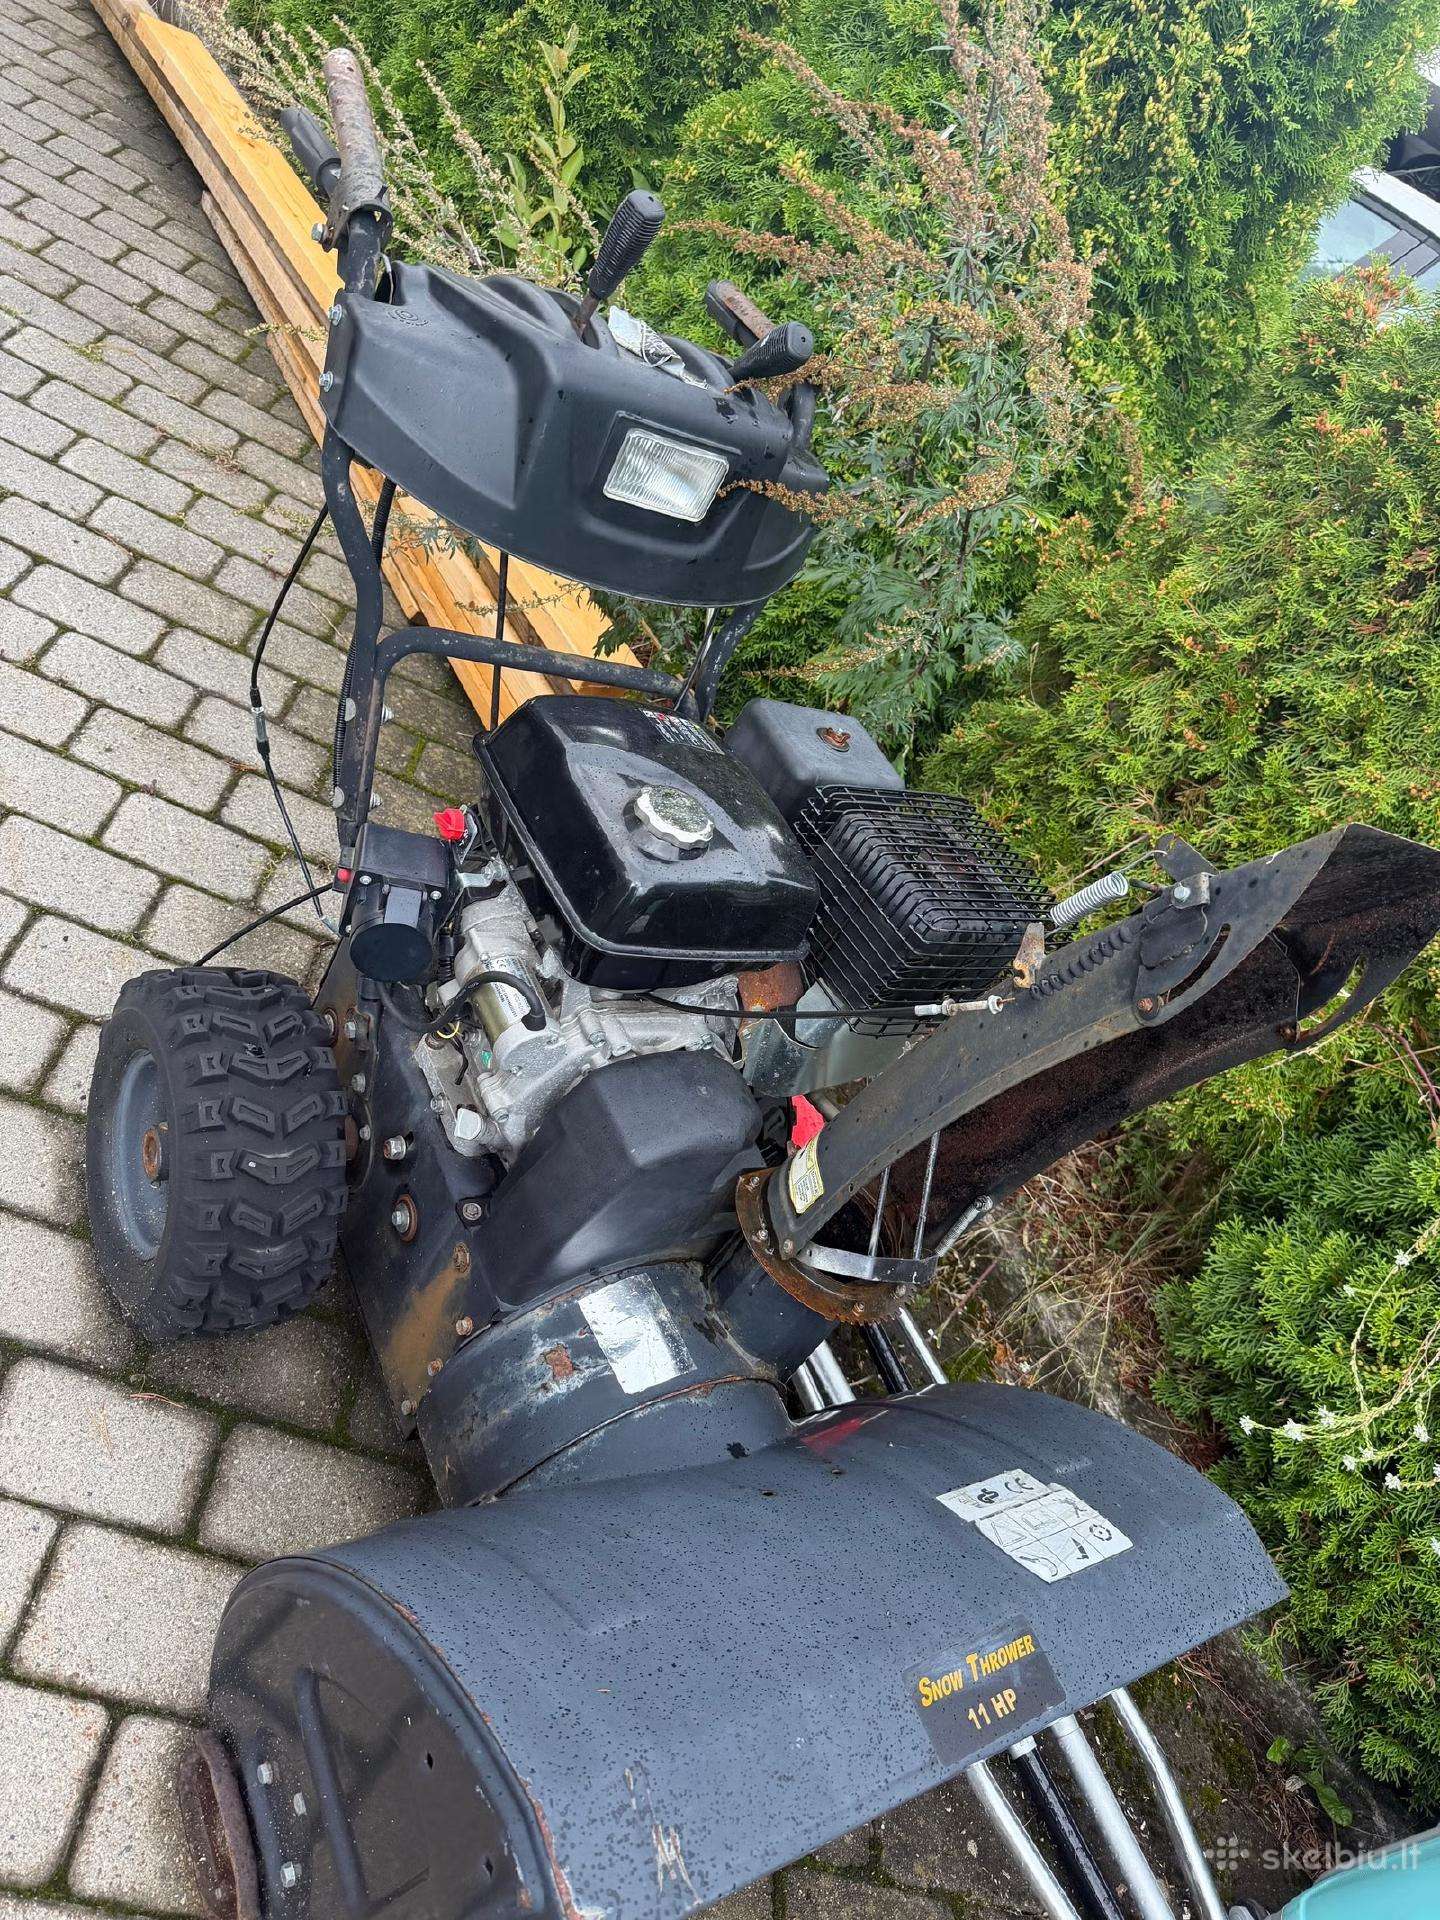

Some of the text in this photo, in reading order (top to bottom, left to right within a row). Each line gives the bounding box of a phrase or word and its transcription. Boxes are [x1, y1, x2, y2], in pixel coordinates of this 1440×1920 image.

[918, 1634, 1036, 1708] SNOW THROWER
[967, 1688, 1017, 1730] 11 HP
